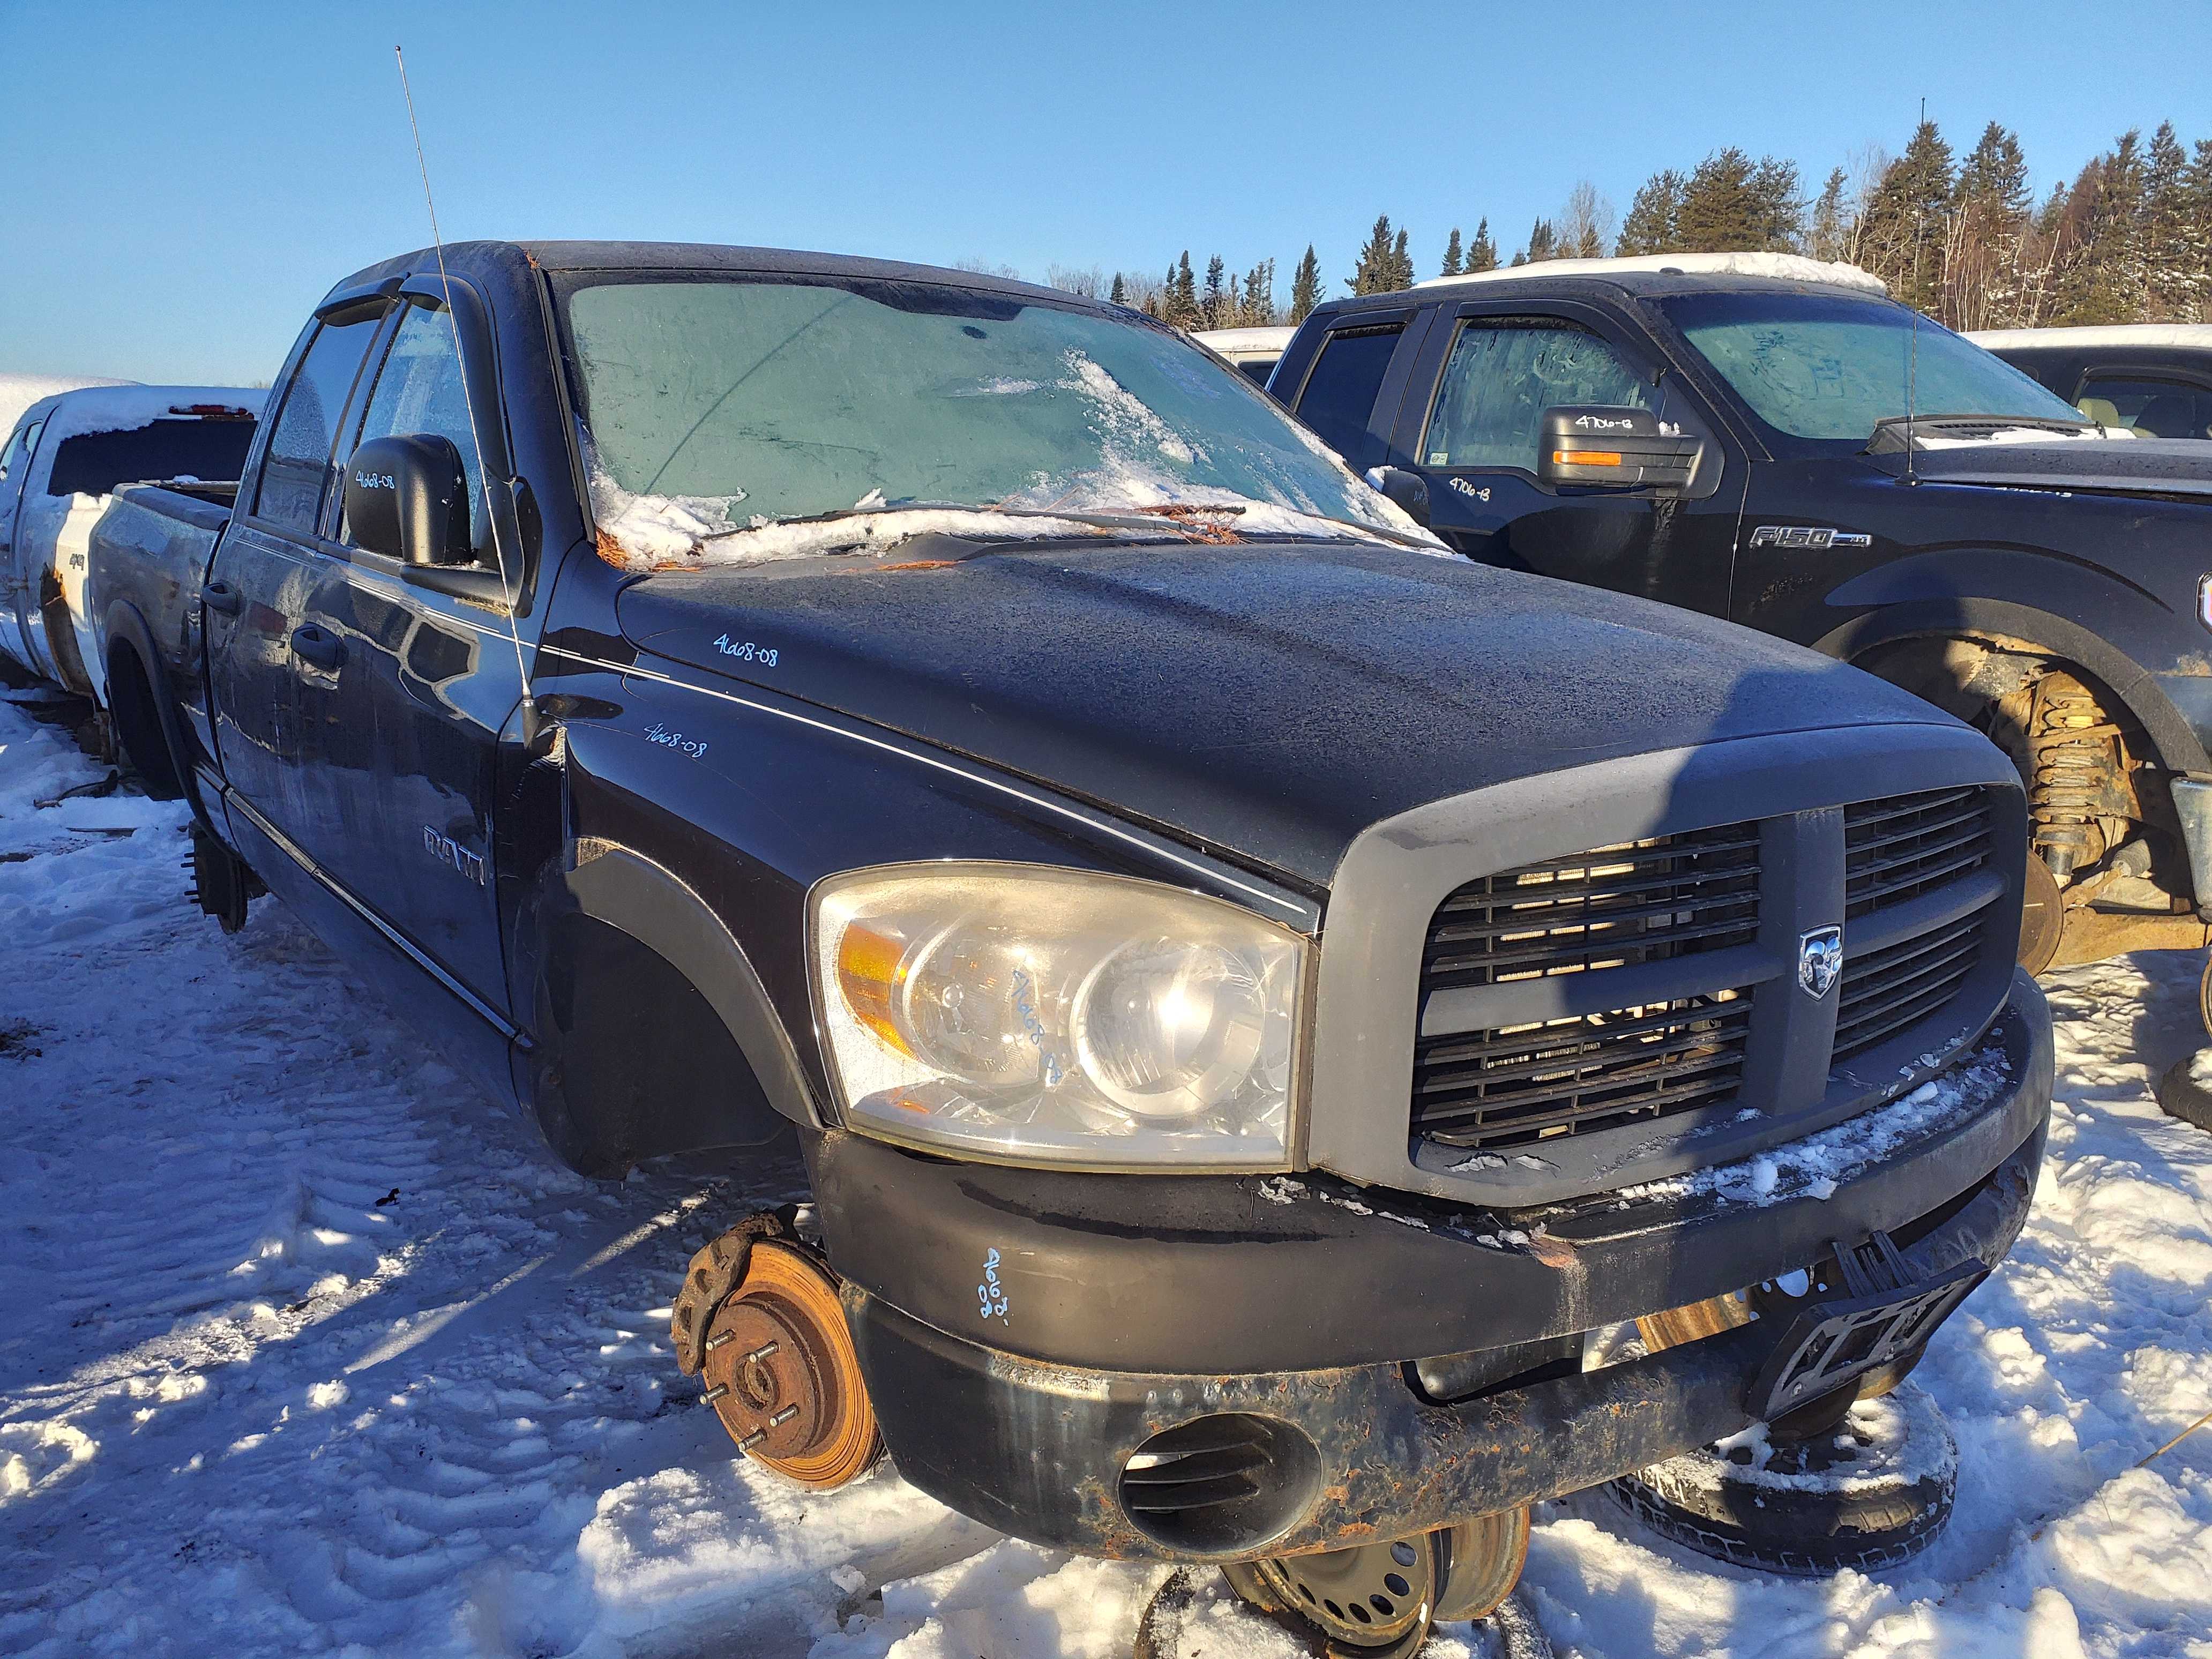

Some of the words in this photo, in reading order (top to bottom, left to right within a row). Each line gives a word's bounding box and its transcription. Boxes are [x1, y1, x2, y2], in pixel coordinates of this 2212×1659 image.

[1575, 415, 1633, 428] 4706-13
[356, 470, 394, 489] 4668-08
[1449, 477, 1490, 502] 4706-13
[713, 633, 778, 667] 4668-08
[644, 723, 707, 757] 4668-08
[423, 824, 484, 885] RAM
